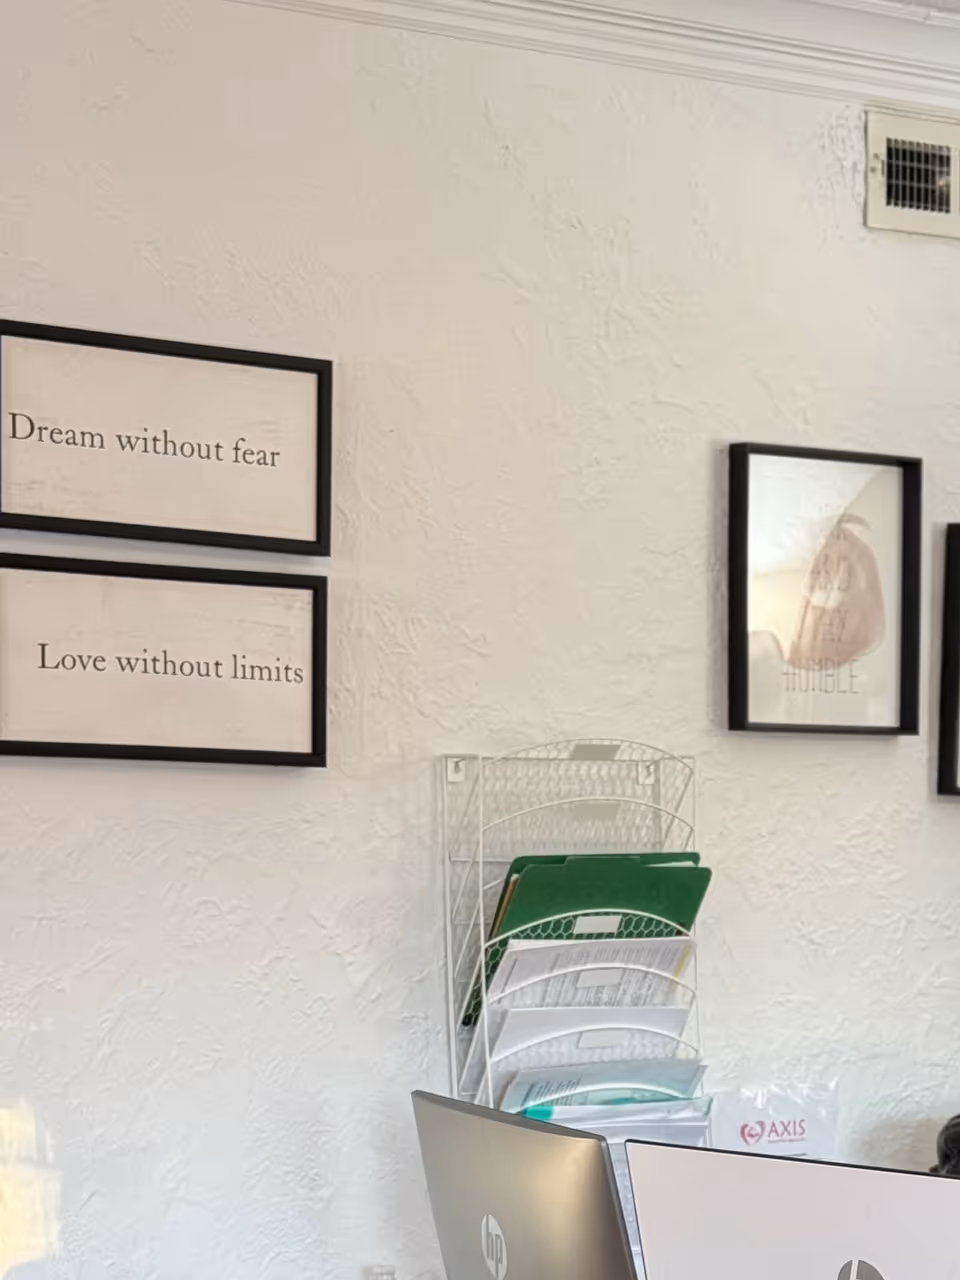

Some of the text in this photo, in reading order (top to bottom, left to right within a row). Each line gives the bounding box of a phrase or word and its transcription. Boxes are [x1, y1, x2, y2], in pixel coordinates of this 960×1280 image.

[8, 411, 281, 468] Dream without fear
[37, 642, 304, 685] Love without limits
[781, 657, 861, 694] HUMBLE
[767, 1119, 806, 1138] AXIS
